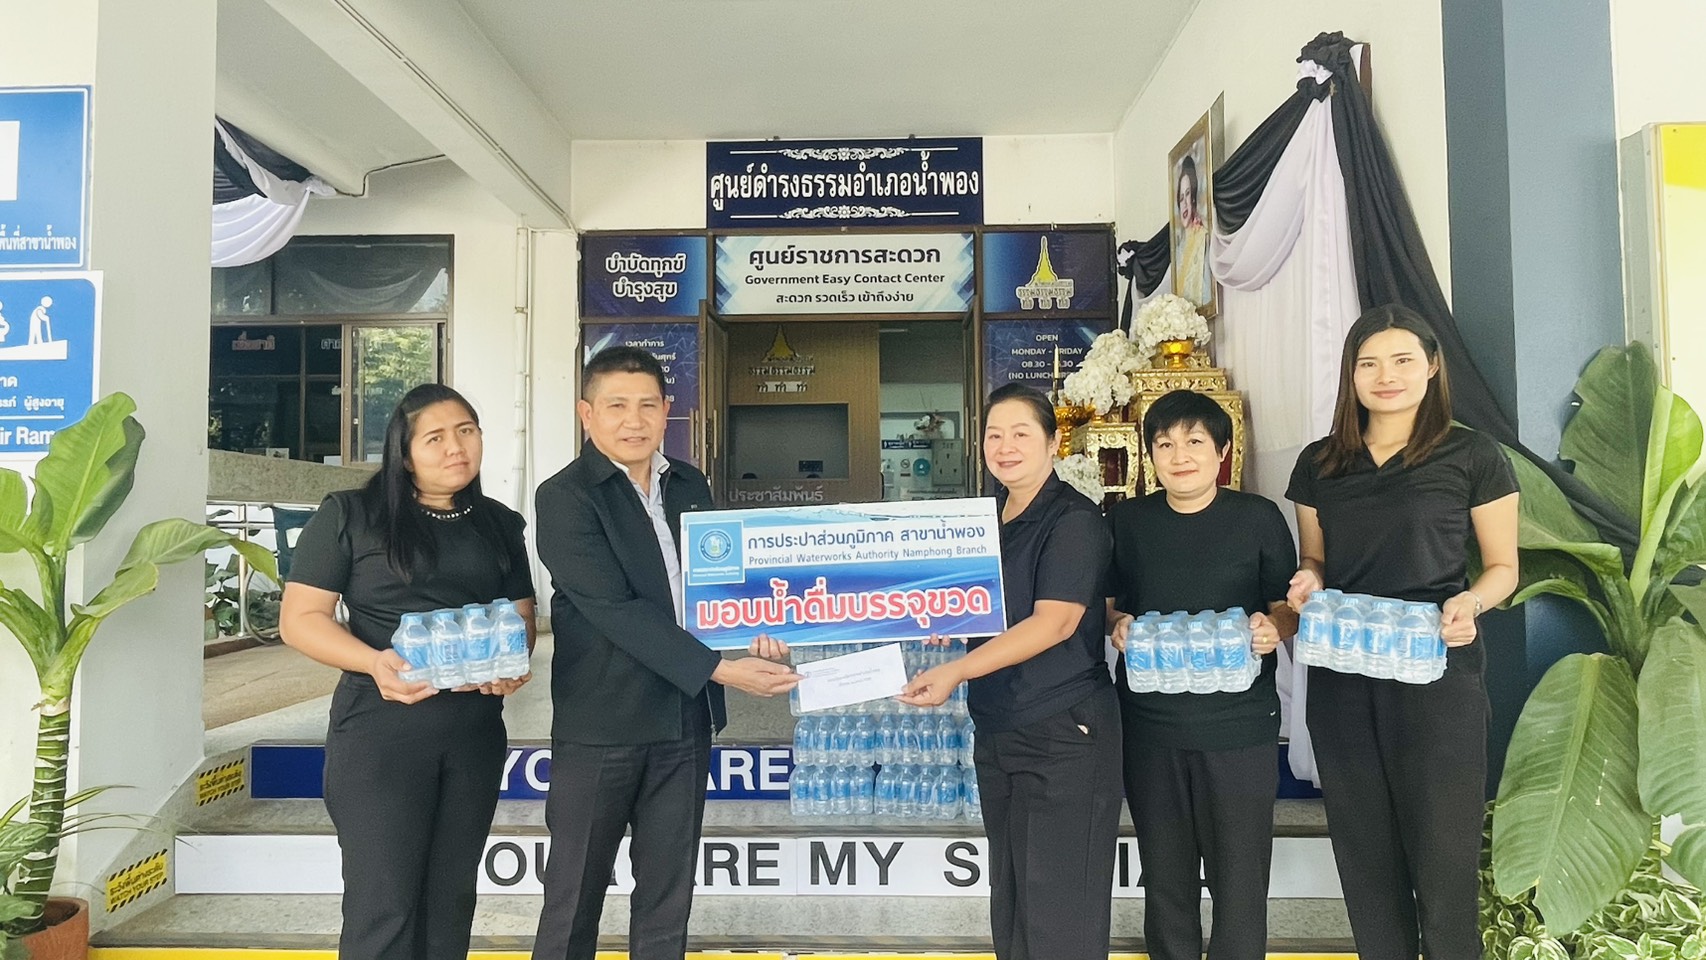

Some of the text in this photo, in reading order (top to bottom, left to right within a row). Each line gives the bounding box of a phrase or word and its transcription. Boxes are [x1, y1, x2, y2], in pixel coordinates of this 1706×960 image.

[710, 150, 979, 210] ศูนย์ดำรงธรรมอำเภอน้ำพอง
[606, 252, 686, 278] บำบัดทุกข์
[749, 245, 941, 271] ศูนย์ราชการสะดวก
[613, 276, 677, 302] บำรุงสุข
[745, 273, 945, 287] Government Easy Contact Center
[776, 290, 914, 304] สะดวก รวดเร็ว เข้าถึงง่าย
[1036, 334, 1059, 342] OPEN
[1011, 347, 1047, 356] MONDAY
[1059, 347, 1083, 355] RIDAY
[1021, 360, 1046, 368] 08.30
[1008, 372, 1024, 380] (NO
[1026, 372, 1054, 380] LUNCH
[24, 395, 65, 411] ผู้สูงอายุ
[729, 485, 824, 502] ประชาสัมพันธ์
[748, 520, 985, 551] การประปาส่วนภูมิภาค สาขาน้ำพอง
[749, 545, 987, 565] Provincial Waterworks Authority Namphong Branch
[697, 578, 992, 628] มอบน้ำดื่มบรรจุขวด
[500, 750, 790, 791] YO RE
[695, 842, 780, 887] RE
[810, 841, 904, 887] MY
